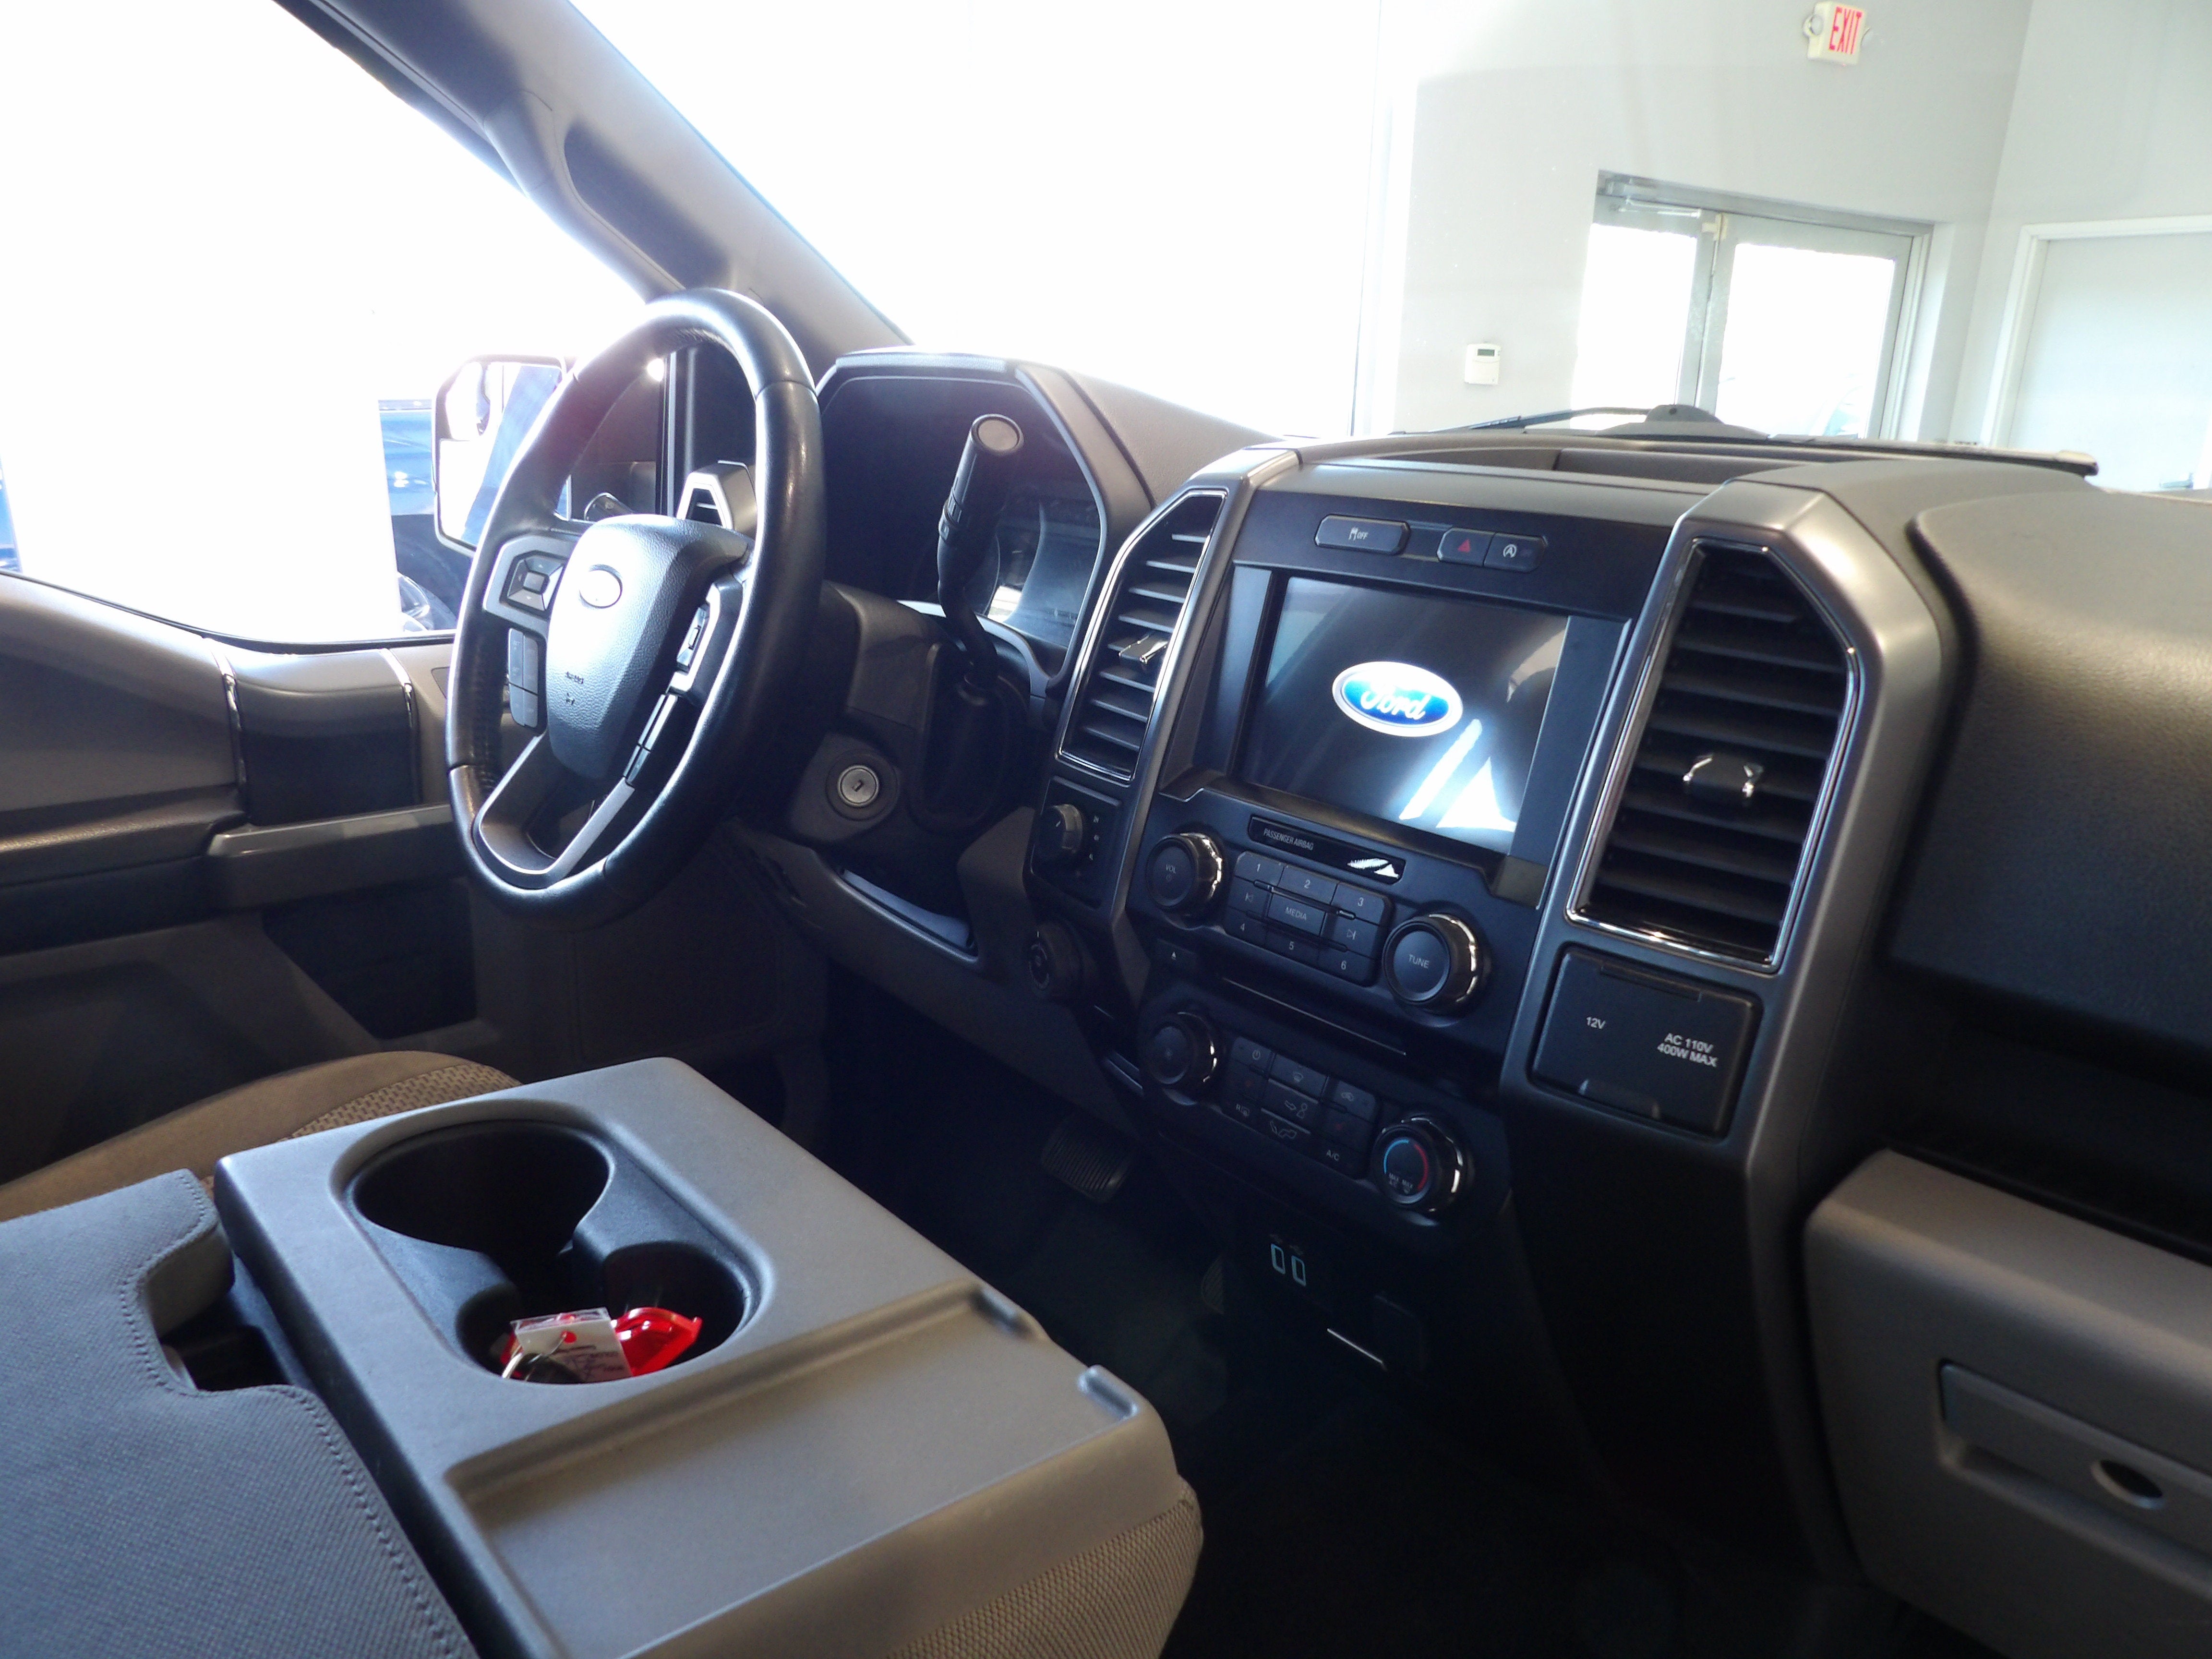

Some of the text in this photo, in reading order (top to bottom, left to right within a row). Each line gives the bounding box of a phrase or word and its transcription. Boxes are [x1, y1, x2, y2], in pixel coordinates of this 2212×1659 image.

[1828, 6, 1863, 55] EXIT
[1357, 531, 1368, 540] OFF
[1263, 828, 1314, 851] PASSENGER AIRBAG
[1166, 864, 1176, 874] VOL
[1256, 864, 1261, 872] 1
[1304, 879, 1310, 889] 2
[1358, 897, 1364, 907] 3
[1285, 907, 1307, 921] MEDIA
[1240, 923, 1245, 931] 4
[1288, 941, 1295, 950] 5
[1341, 961, 1346, 970] 6
[1408, 954, 1430, 969] TUNE
[1586, 1016, 1606, 1029] 12V
[1664, 1033, 1714, 1053] AC 110V
[1657, 1043, 1718, 1067] 400W MAX
[1326, 1149, 1340, 1161] A/C
